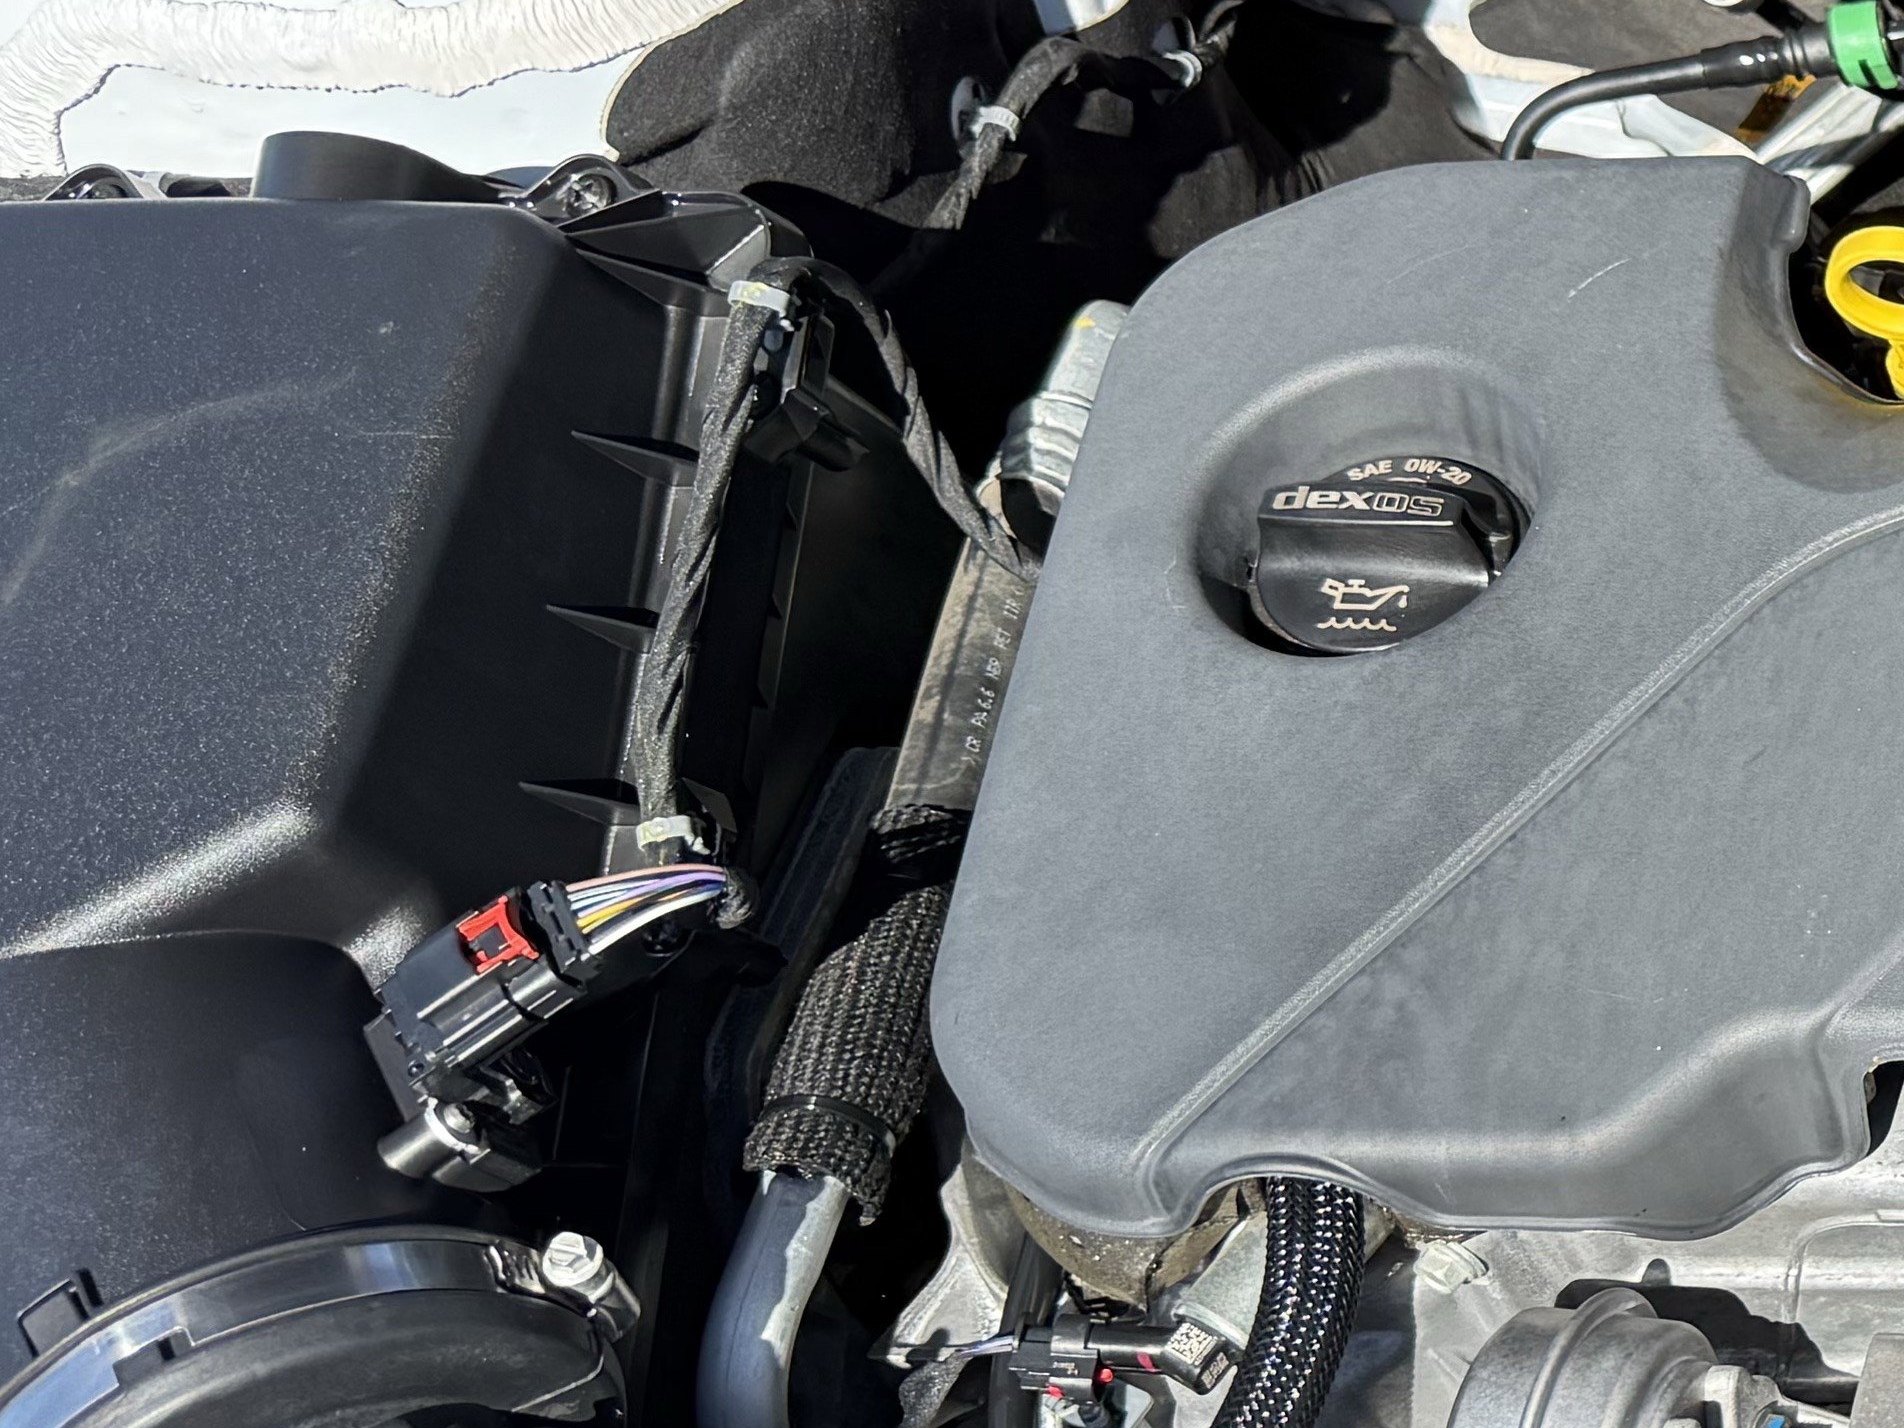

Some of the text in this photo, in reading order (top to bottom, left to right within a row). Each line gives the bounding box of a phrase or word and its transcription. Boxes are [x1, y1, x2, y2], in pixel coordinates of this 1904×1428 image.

[1346, 458, 1473, 486] SAE 0W-20
[1272, 485, 1445, 517] dexos
